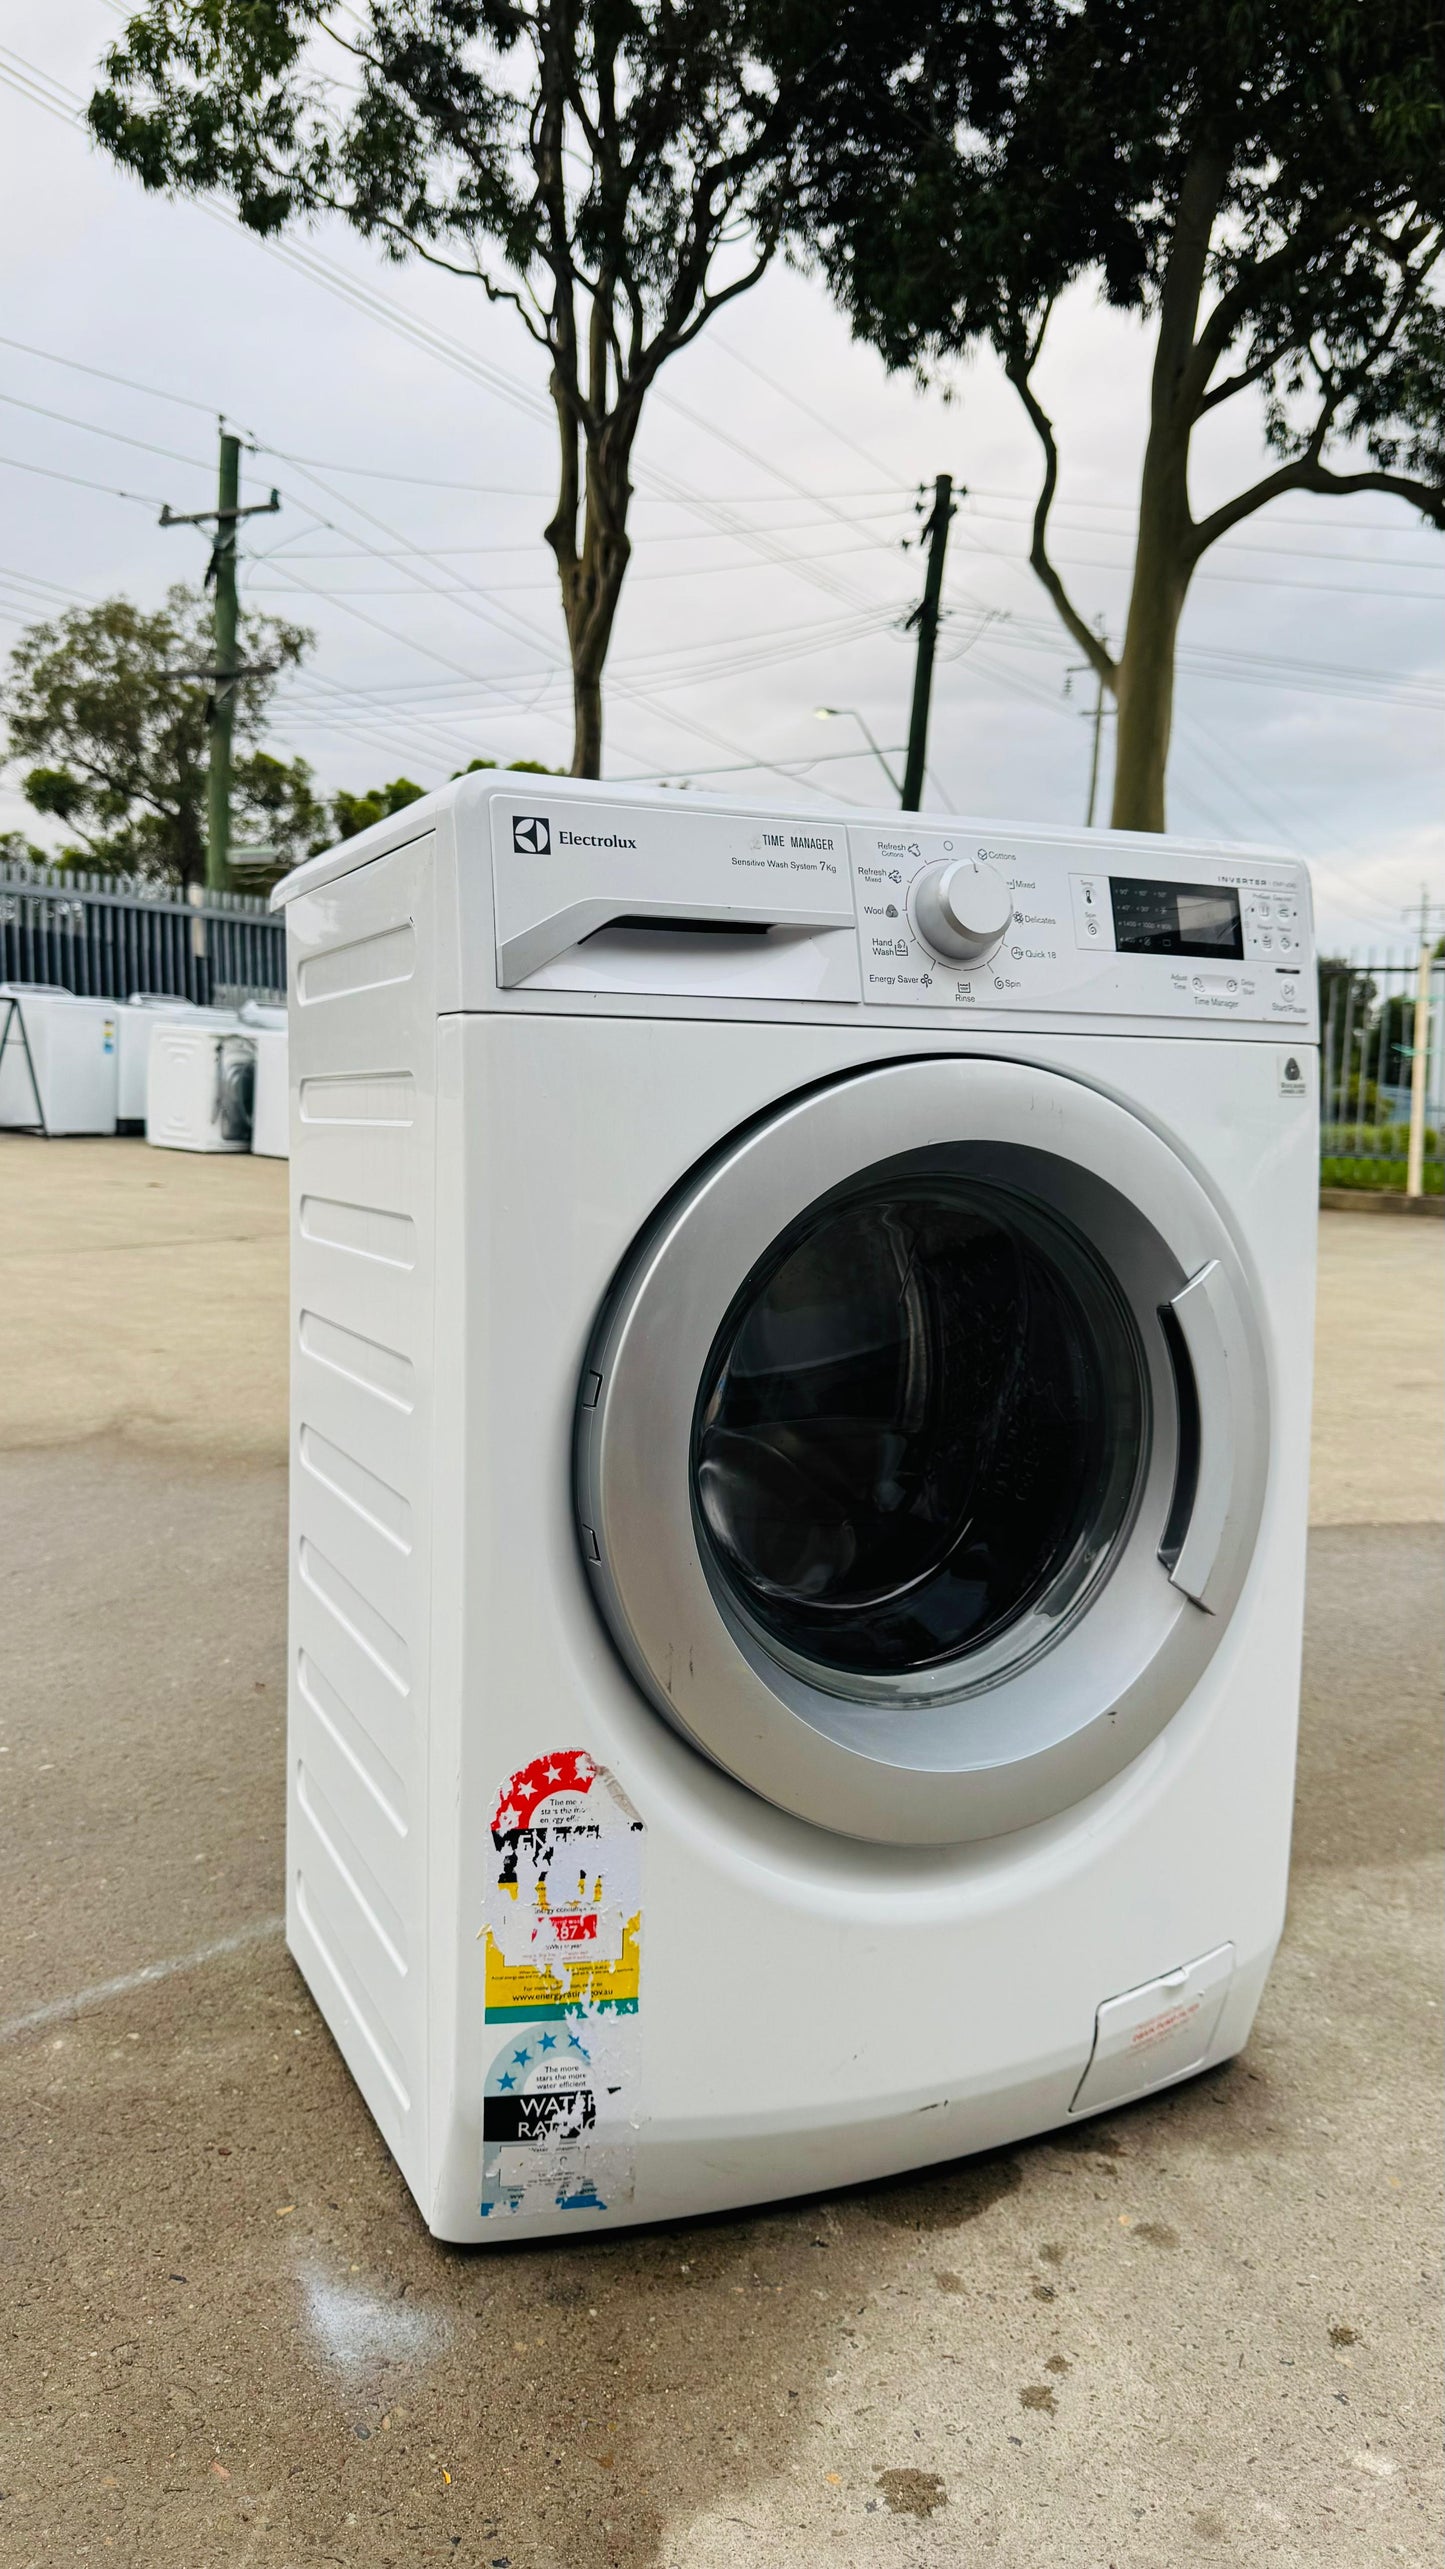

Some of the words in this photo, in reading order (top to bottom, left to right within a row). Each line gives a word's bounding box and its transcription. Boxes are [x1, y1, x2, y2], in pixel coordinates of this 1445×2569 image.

[558, 830, 637, 849] Electrolux
[762, 834, 785, 847] TIME
[790, 836, 834, 851] MANAGER
[877, 841, 906, 852] Refresh
[988, 851, 1017, 861] Cottons
[731, 857, 765, 867] Sensitive
[767, 859, 789, 869] Wash
[790, 861, 818, 872] System
[819, 861, 837, 874] 7Kg
[858, 866, 887, 877] Refresh
[1015, 881, 1036, 890] Mixed
[1218, 876, 1267, 886] INVERTER
[864, 906, 884, 915] Wool
[1024, 915, 1056, 925] Delicates
[872, 938, 893, 947] Hand
[872, 947, 894, 957] Wash
[1025, 950, 1045, 959] Quick
[1047, 951, 1057, 959] 18
[869, 974, 896, 985] Energy
[897, 975, 919, 985] Saver
[1005, 979, 1021, 989] Spin
[955, 994, 975, 1003] Rinse
[1194, 996, 1210, 1006] Time
[1211, 998, 1239, 1009] Manager
[550, 1798, 564, 1806] The
